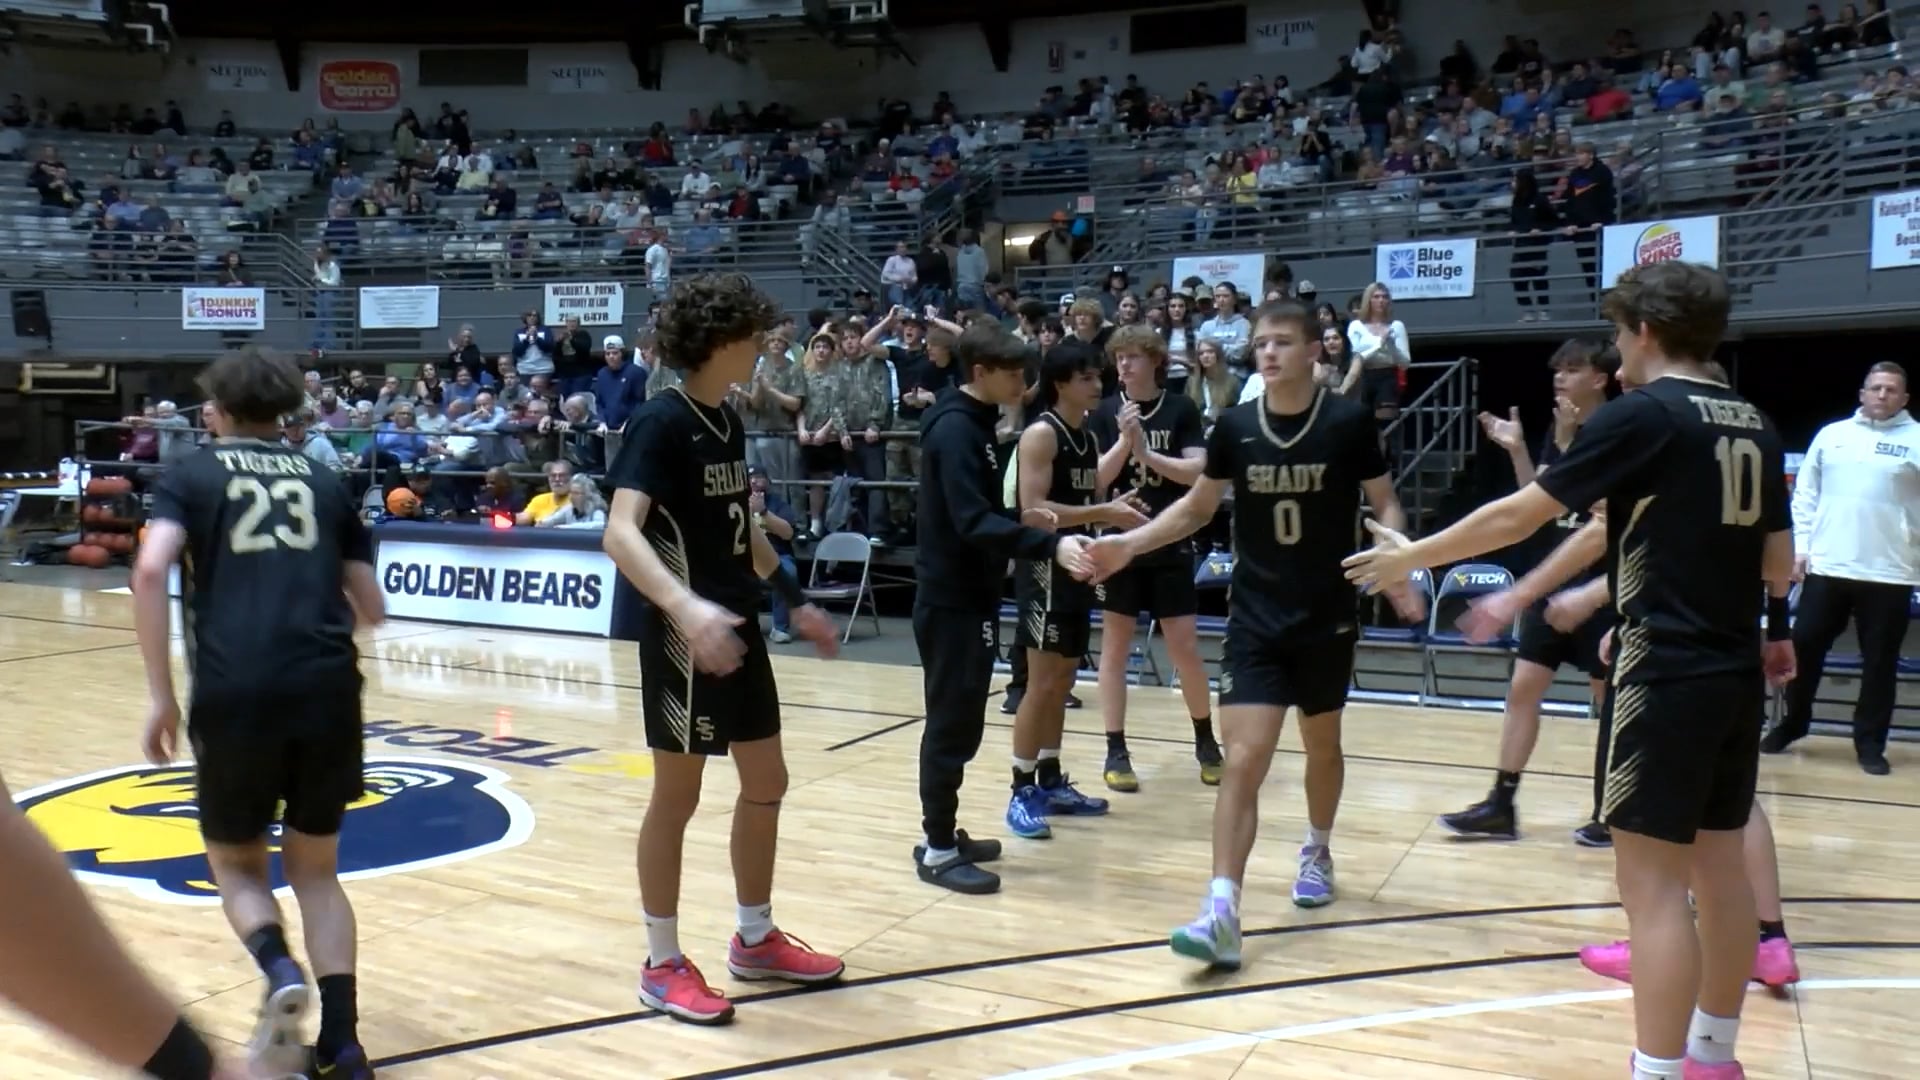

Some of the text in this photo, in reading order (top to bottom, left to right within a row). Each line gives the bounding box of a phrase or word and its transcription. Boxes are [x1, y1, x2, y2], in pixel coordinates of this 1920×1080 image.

[1418, 247, 1454, 261] Blue
[1416, 263, 1463, 280] Ridge
[206, 308, 257, 318] DONUTS
[1687, 394, 1764, 430] TIGERS
[214, 449, 313, 476] TIGERS
[1874, 441, 1910, 458] SHADY
[1246, 464, 1328, 493] SHADY
[1714, 435, 1762, 526] 10
[226, 475, 319, 554] 23
[728, 502, 747, 556] 2
[1273, 499, 1302, 545] 0
[383, 561, 602, 610] GOLDEN BEARS
[1470, 571, 1507, 584] TECH
